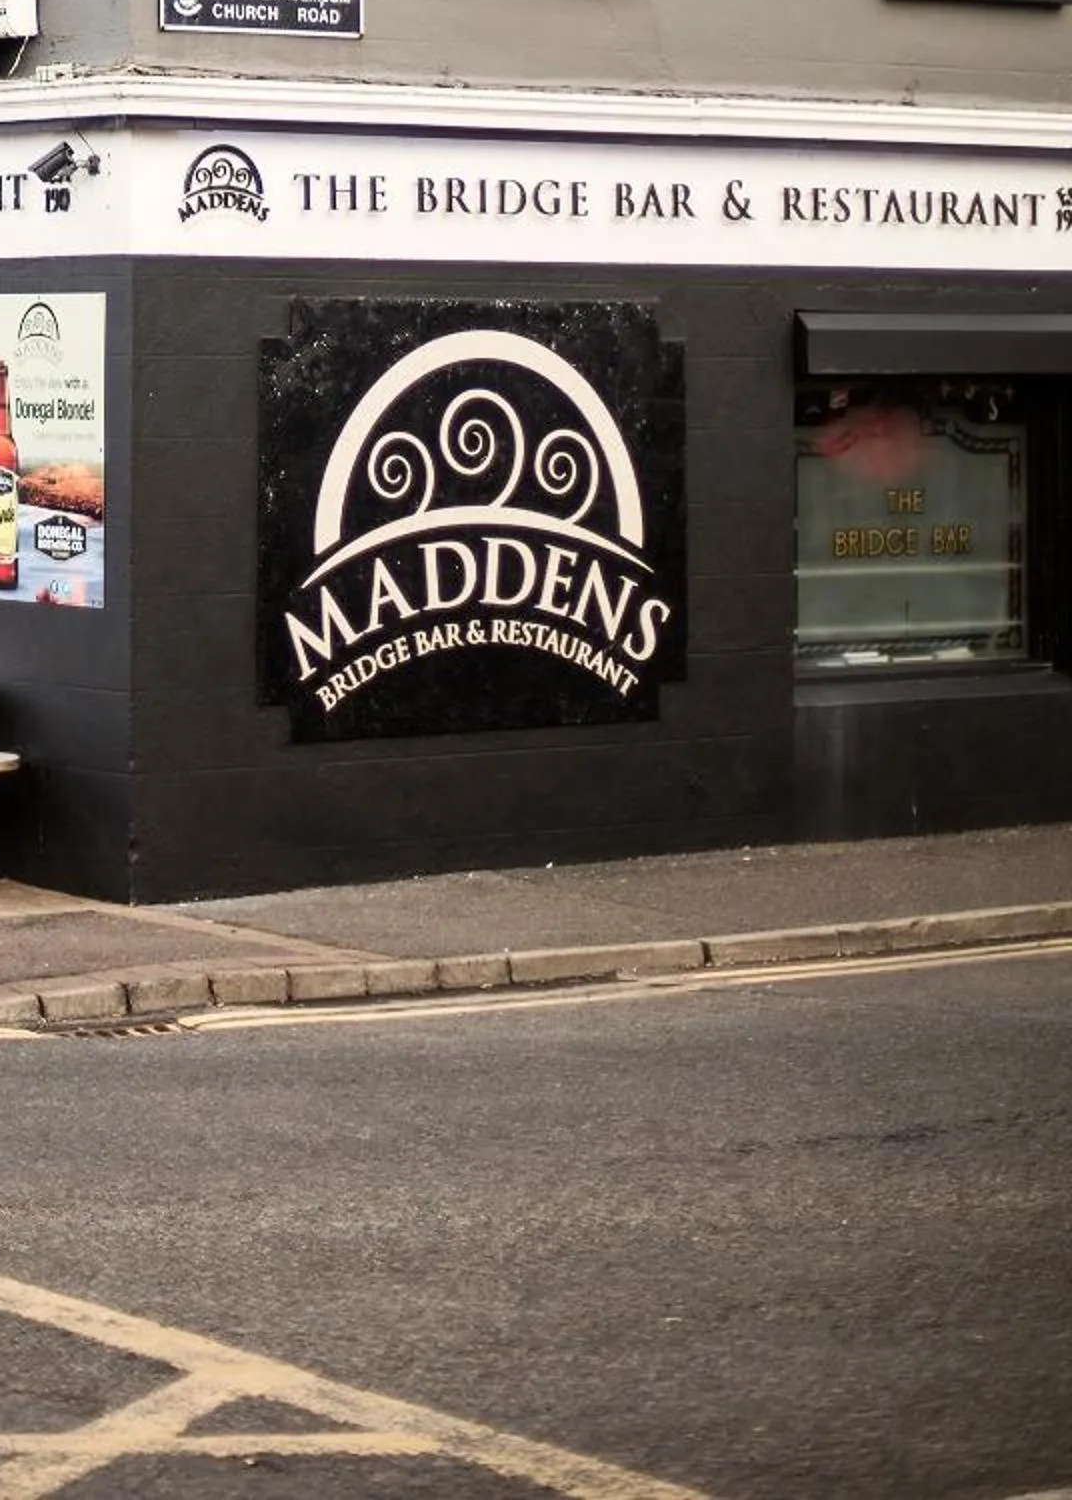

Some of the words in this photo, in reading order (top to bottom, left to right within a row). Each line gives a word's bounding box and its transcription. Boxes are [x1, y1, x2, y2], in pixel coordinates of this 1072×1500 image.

[211, 3, 279, 21] CHURCH
[297, 7, 341, 25] ROAD
[177, 191, 270, 223] MADDENS
[293, 173, 388, 213] THE
[416, 176, 590, 217] BRIDGE
[614, 182, 696, 219] BAR
[721, 179, 754, 222] &
[781, 186, 1047, 228] RESTAURANT
[15, 397, 55, 425] Donegal
[887, 489, 925, 514] THE
[37, 525, 85, 541] DONEGAL
[834, 528, 918, 558] BRIDGE
[931, 525, 972, 555] BAR
[284, 537, 671, 681] MADDENS
[315, 637, 411, 712] BRIDGE
[414, 622, 466, 658] BAR
[466, 619, 485, 645] &
[491, 619, 640, 698] RESTAURANT
